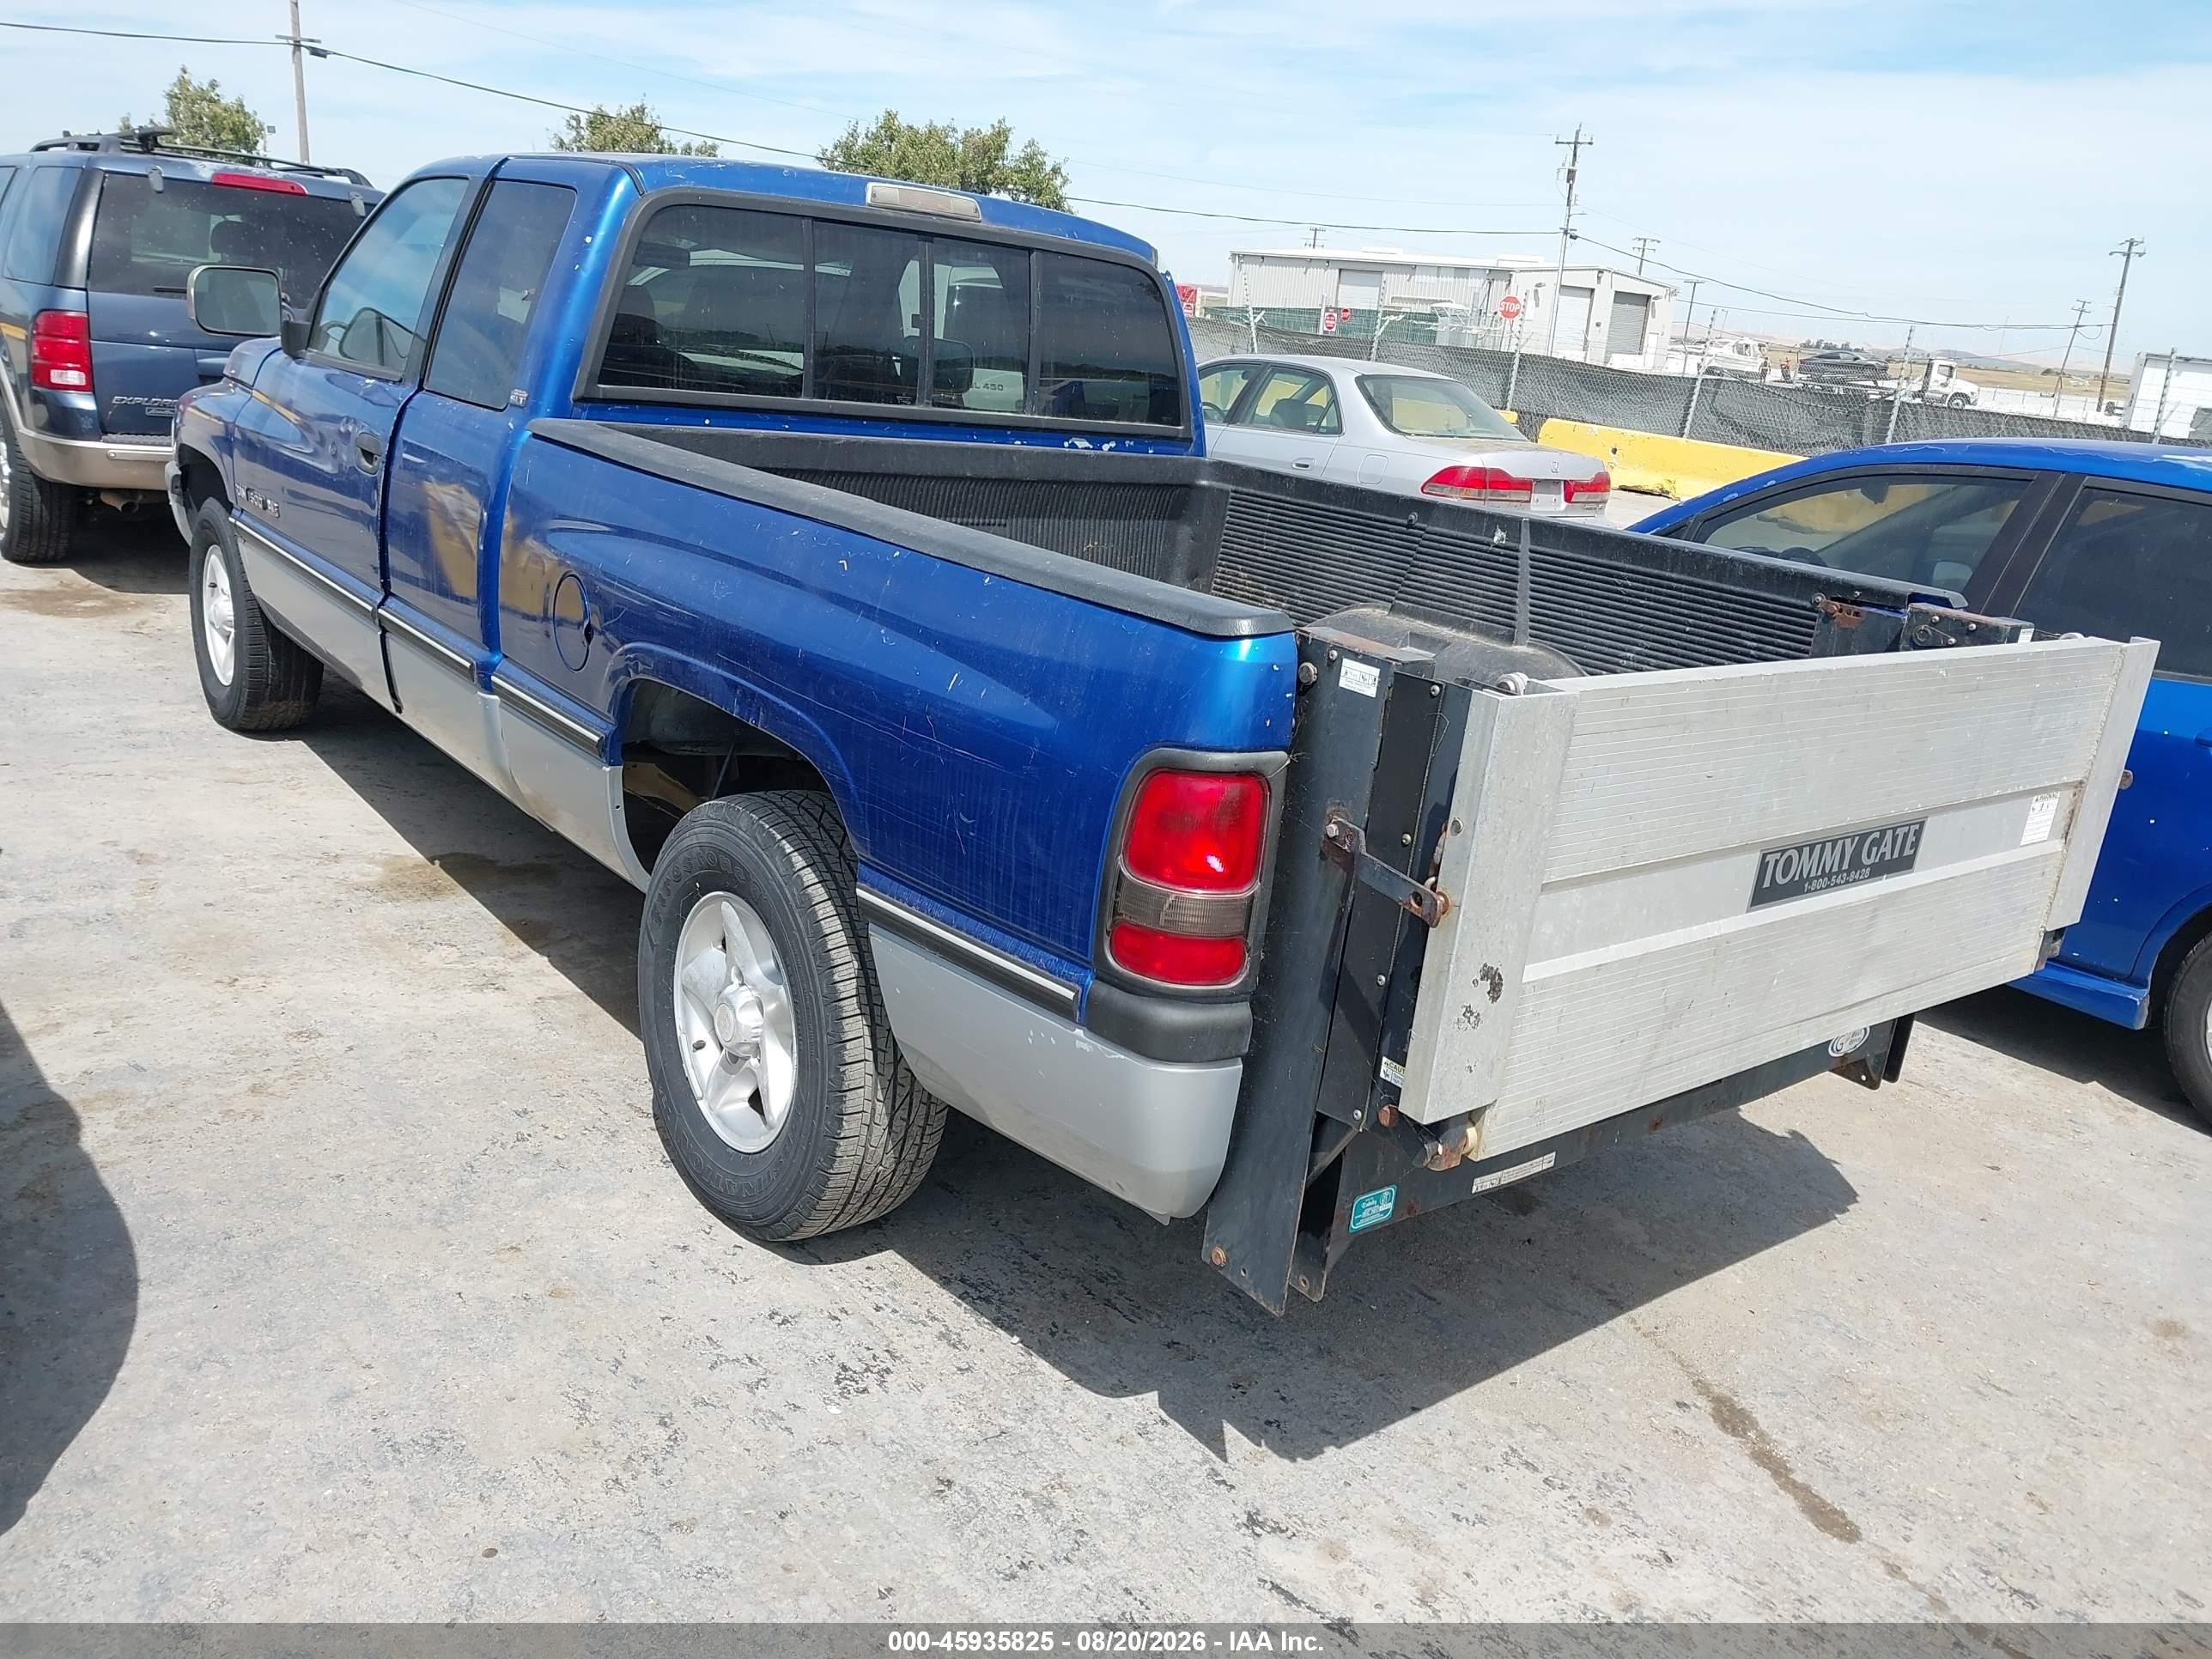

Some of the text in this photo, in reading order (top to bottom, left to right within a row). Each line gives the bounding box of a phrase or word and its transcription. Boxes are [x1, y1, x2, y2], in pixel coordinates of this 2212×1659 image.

[1499, 301, 1521, 313] STOP
[982, 382, 1004, 392] 450
[510, 395, 526, 407] SLT
[1762, 823, 1920, 889] TOMMY GATE
[1804, 867, 1871, 894] 1-800-543-8428
[1388, 1060, 1407, 1075] CAUT
